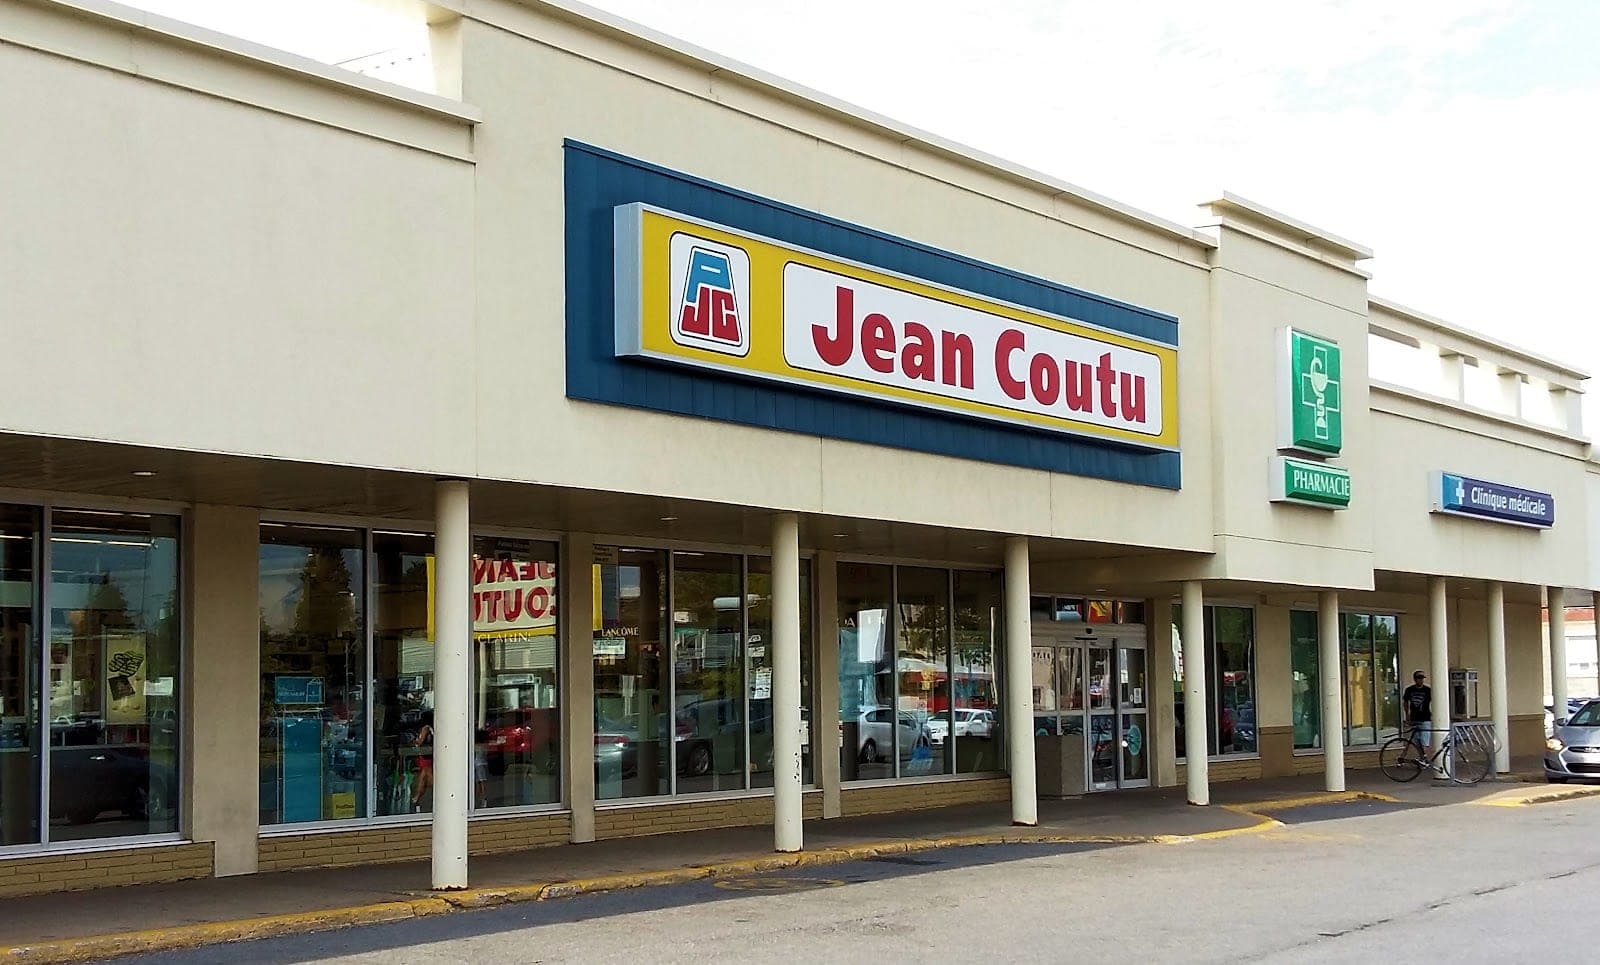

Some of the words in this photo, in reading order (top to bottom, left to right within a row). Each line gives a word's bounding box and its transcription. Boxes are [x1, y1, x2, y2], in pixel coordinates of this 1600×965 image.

[812, 286, 974, 389] Jean
[995, 329, 1146, 422] Coutu
[1293, 469, 1350, 497] PHARMACIE
[1471, 486, 1508, 512] Clinique
[1508, 494, 1546, 516] médicale
